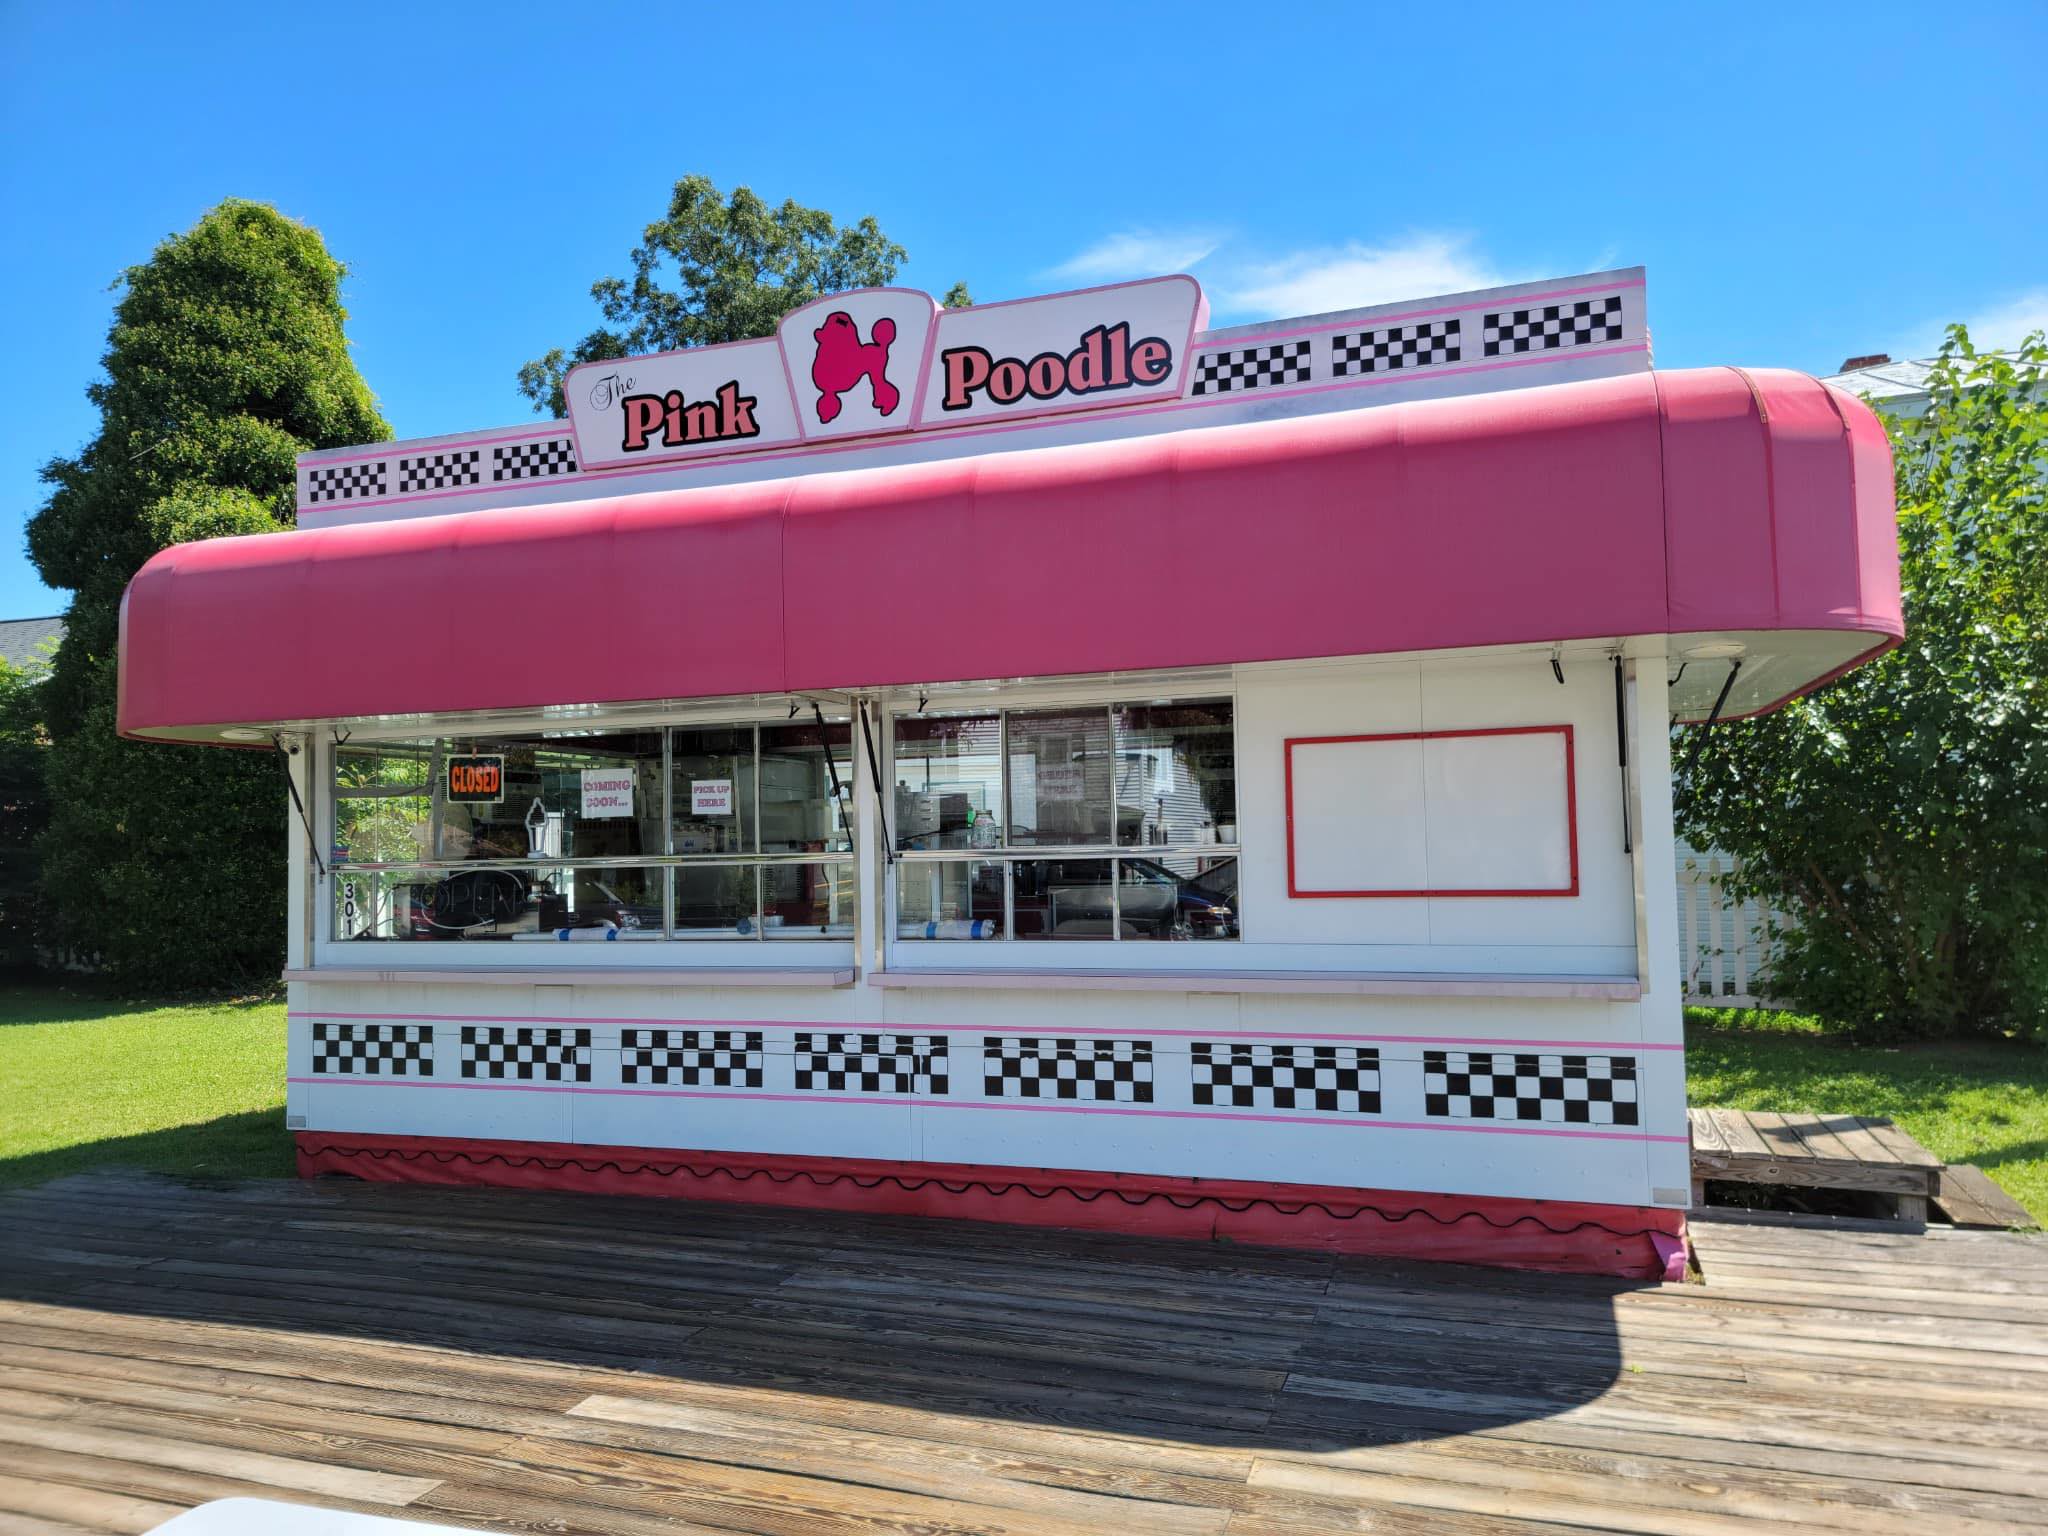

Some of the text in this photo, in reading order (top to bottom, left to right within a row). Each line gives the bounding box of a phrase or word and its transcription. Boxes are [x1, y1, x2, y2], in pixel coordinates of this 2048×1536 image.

[590, 371, 637, 411] The
[622, 321, 1173, 452] Pink Poodle
[451, 765, 499, 793] CLOSED
[583, 780, 631, 792] COMING
[693, 785, 730, 794] PICK UP
[697, 798, 726, 807] HERE
[344, 882, 355, 936] 301
